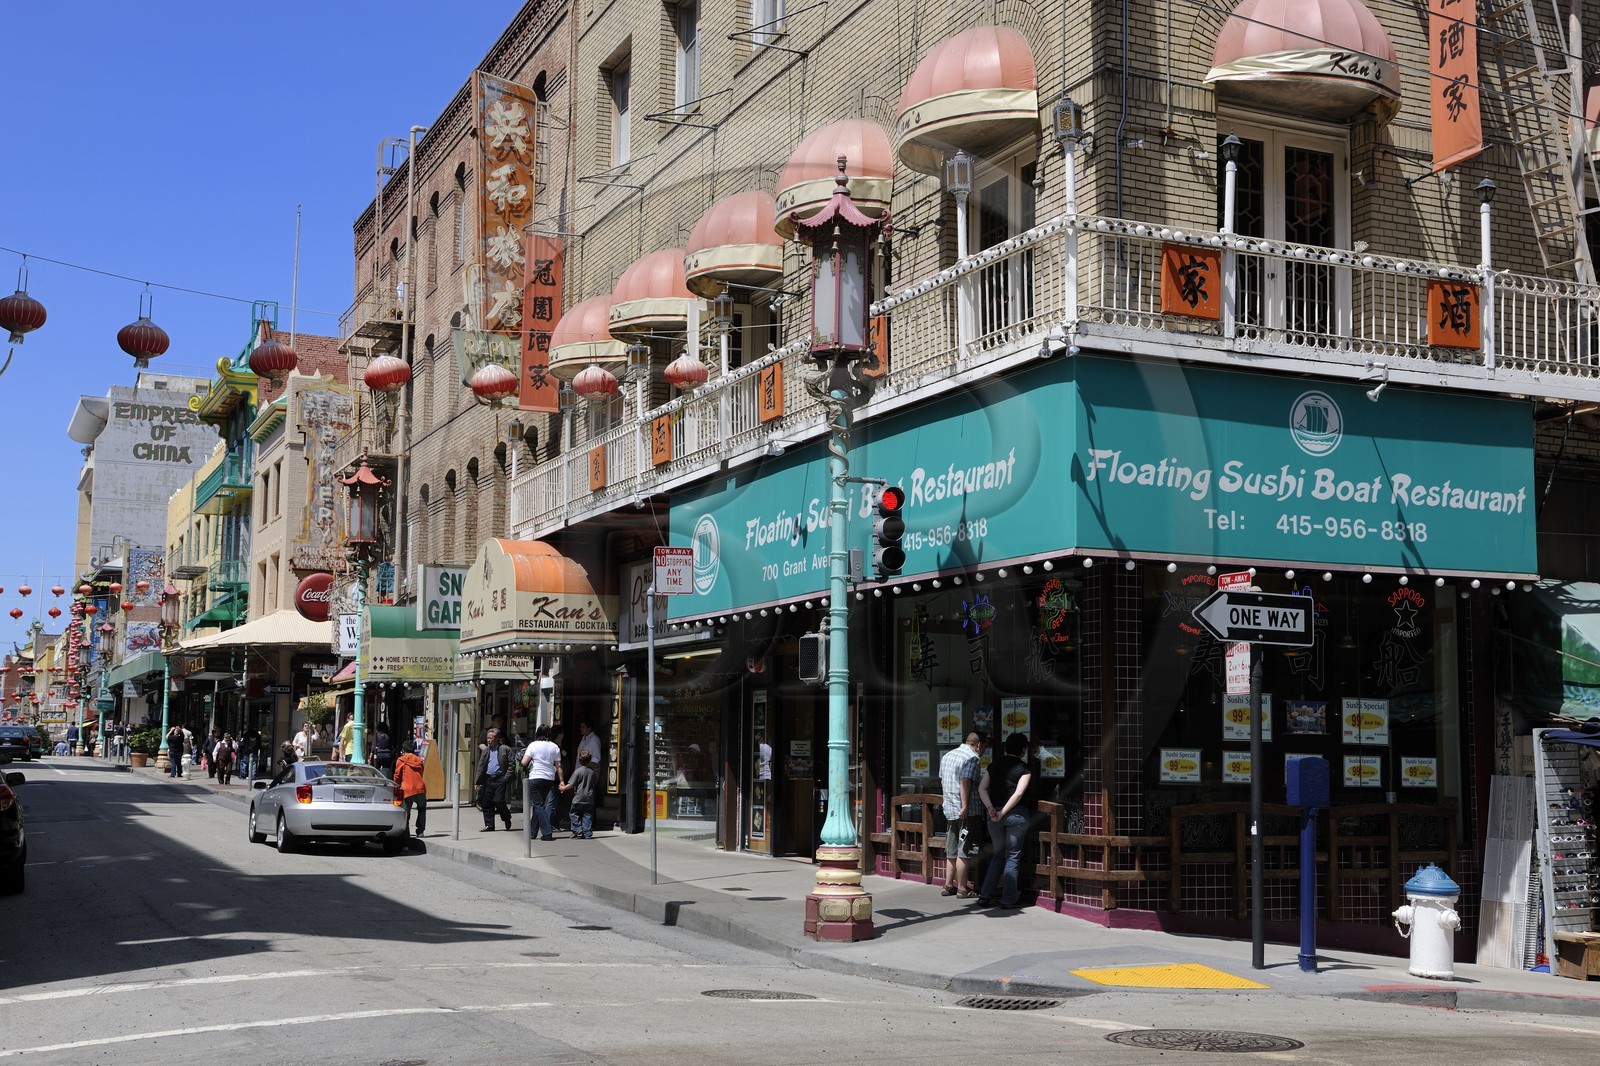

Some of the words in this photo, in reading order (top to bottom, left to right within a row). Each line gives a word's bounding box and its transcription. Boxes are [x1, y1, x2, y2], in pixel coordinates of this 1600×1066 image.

[1329, 52, 1382, 81] Kan's
[1178, 254, 1210, 310] 家
[1439, 288, 1472, 335] 酒
[113, 402, 200, 425] EMPRES
[150, 425, 177, 442] OF
[132, 442, 193, 464] CHINA
[1086, 448, 1212, 500] Floating
[1218, 460, 1306, 501] Sushi
[1311, 467, 1382, 504] Boat
[1389, 473, 1527, 516] Restaurant
[745, 510, 802, 551] Floating
[807, 484, 853, 533] Sui
[910, 447, 1016, 508] Restaurant
[1203, 508, 1245, 531] Tel:
[1276, 514, 1428, 543] 415-956-8318
[762, 563, 779, 582] 700
[783, 558, 807, 577] Grant
[904, 517, 988, 551] 415-956-8318
[656, 556, 666, 566] NO
[667, 558, 692, 567] STOPPING
[666, 578, 682, 586] TIME
[1182, 574, 1216, 586] IMPORTED
[532, 596, 602, 620] Kan's
[1387, 587, 1425, 608] SAPPORO
[518, 619, 569, 630] RESTAURANT
[575, 621, 617, 631] COCKTAILS
[1052, 609, 1067, 629] BEER
[1229, 607, 1261, 626] ONE
[1267, 610, 1300, 629] WAY
[1390, 626, 1421, 638] IMPORTED
[488, 660, 529, 668] RESTAURANT
[100, 690, 108, 698] P
[1227, 696, 1244, 704] Sushi
[1345, 701, 1361, 710] Sushi
[1363, 702, 1385, 710] Special
